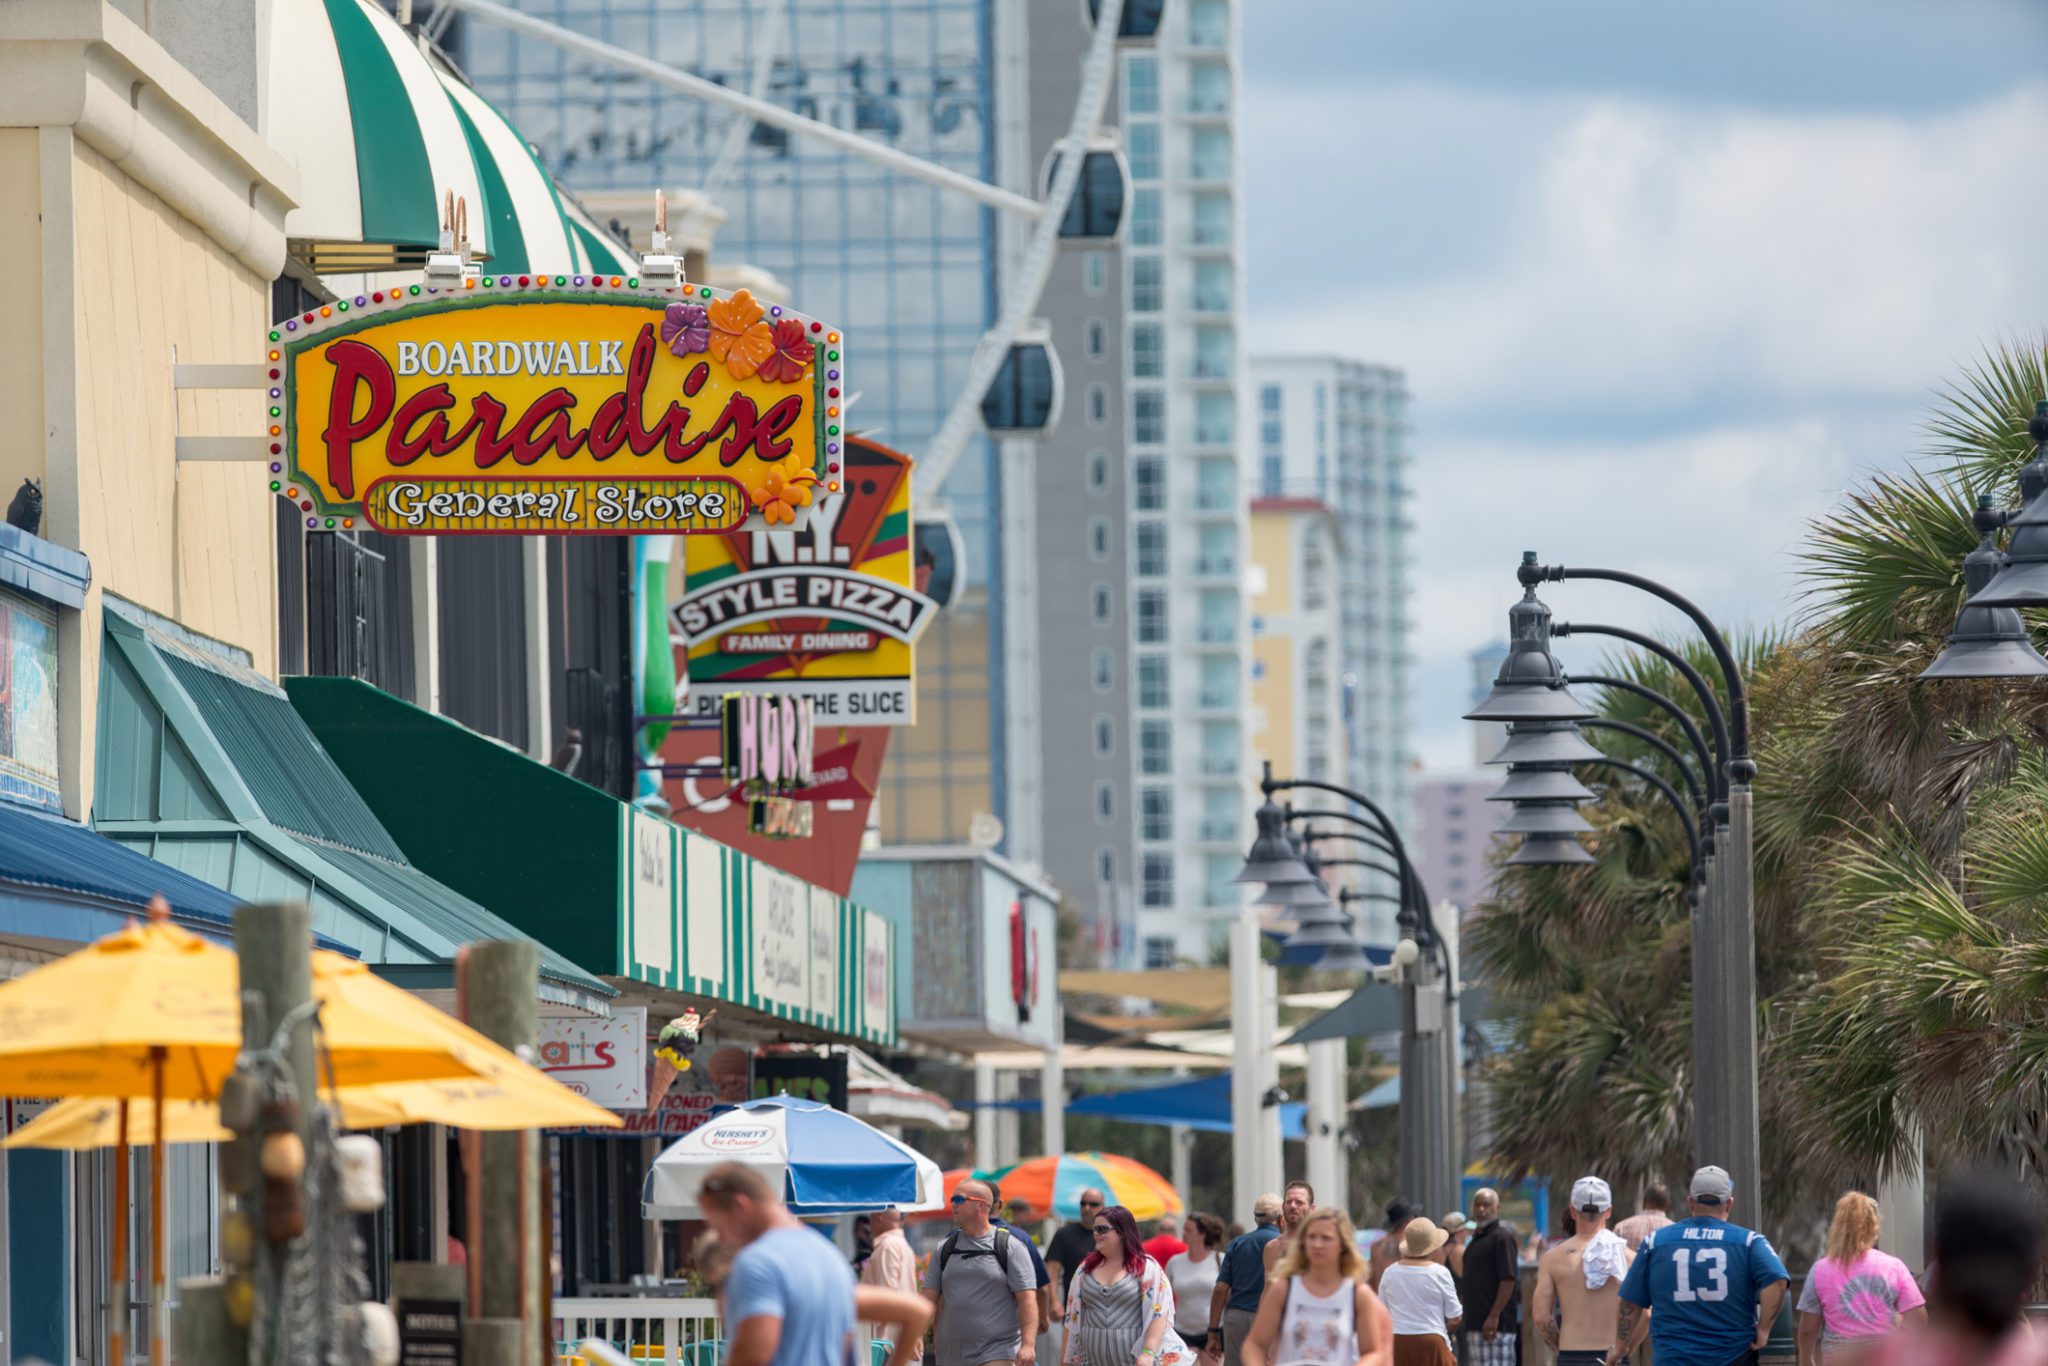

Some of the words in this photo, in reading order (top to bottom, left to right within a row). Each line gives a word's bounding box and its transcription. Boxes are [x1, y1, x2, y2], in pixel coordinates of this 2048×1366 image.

[397, 341, 625, 376] BOARDWALK
[322, 322, 803, 500] Paradise
[386, 482, 580, 525] General
[594, 485, 726, 524] Store
[678, 577, 798, 633] STYLE
[808, 576, 914, 630] PIZZA
[728, 634, 796, 650] FAMILY
[802, 633, 869, 649] DINING
[848, 692, 904, 714] SLICE
[713, 1129, 768, 1138] HERSHEY'S
[1682, 1228, 1724, 1240] HILTON
[1672, 1247, 1728, 1301] 13
